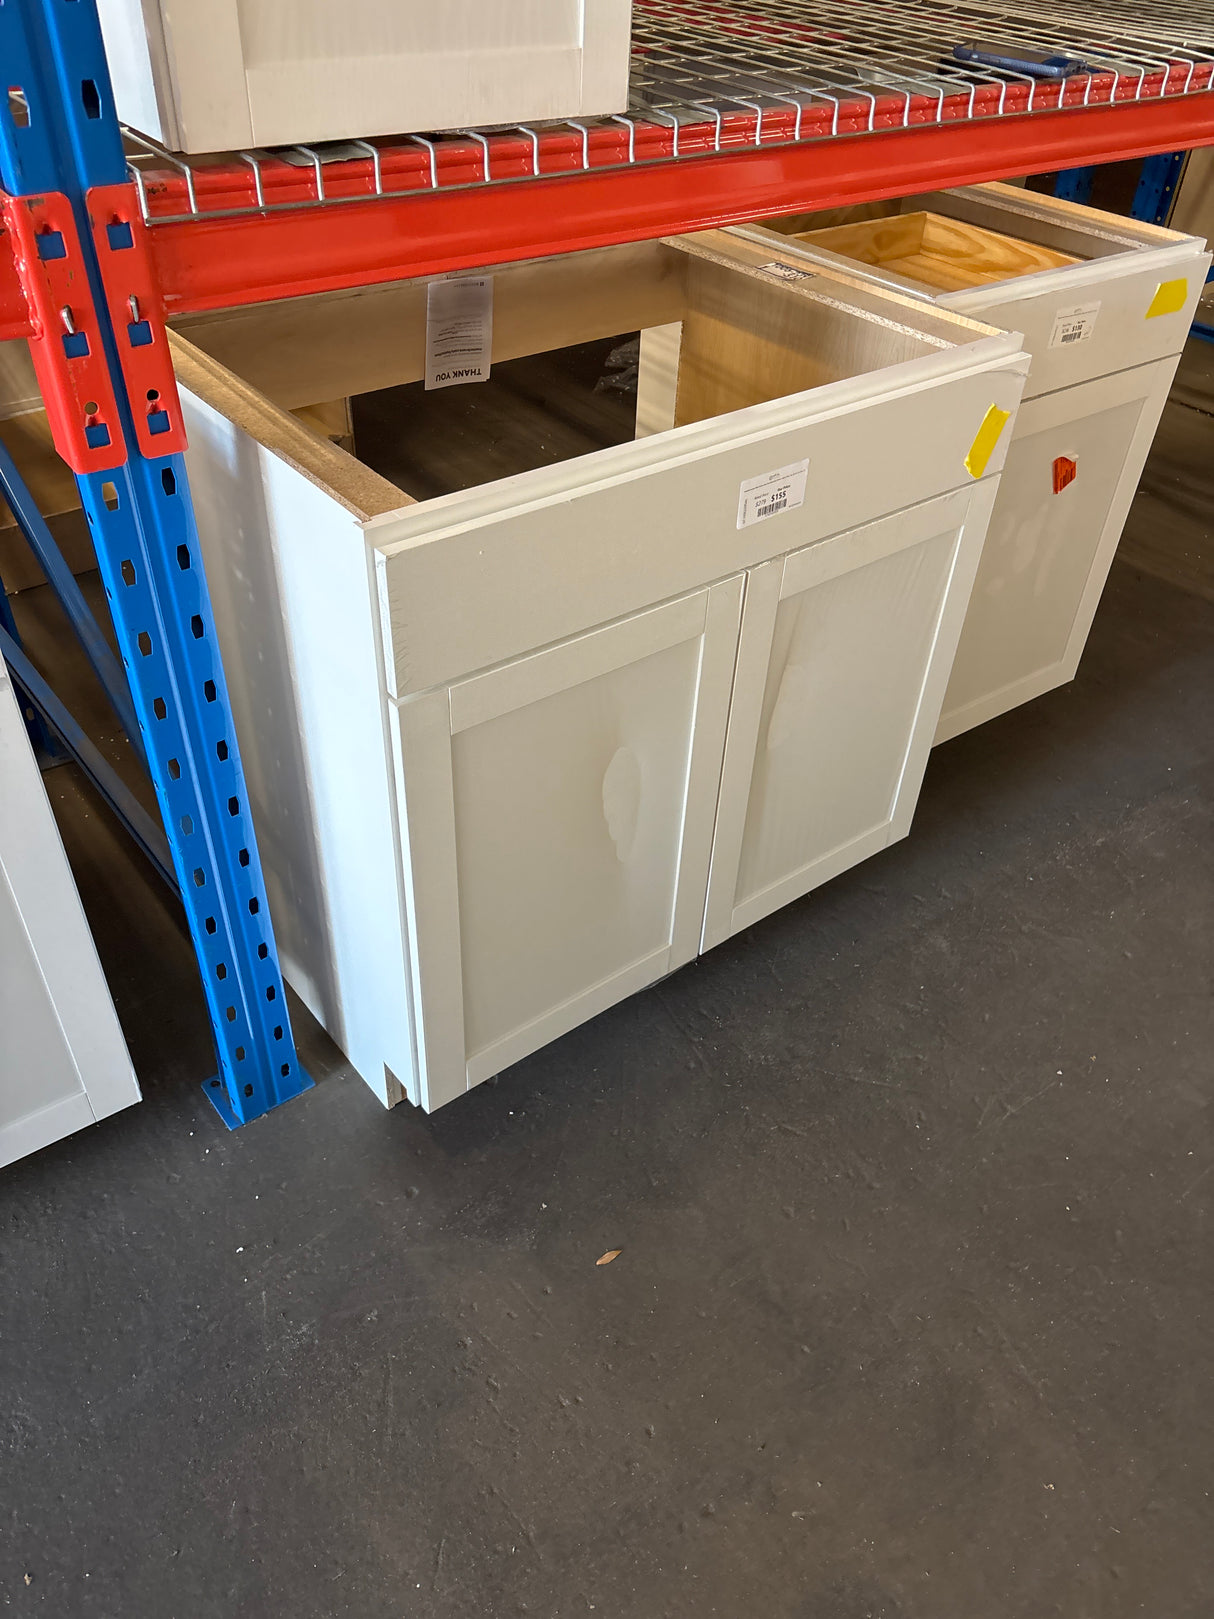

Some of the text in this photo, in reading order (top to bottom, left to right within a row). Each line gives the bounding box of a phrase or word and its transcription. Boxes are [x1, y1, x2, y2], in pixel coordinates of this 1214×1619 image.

[435, 368, 482, 382] THANK YOU
[771, 491, 786, 502] $155
